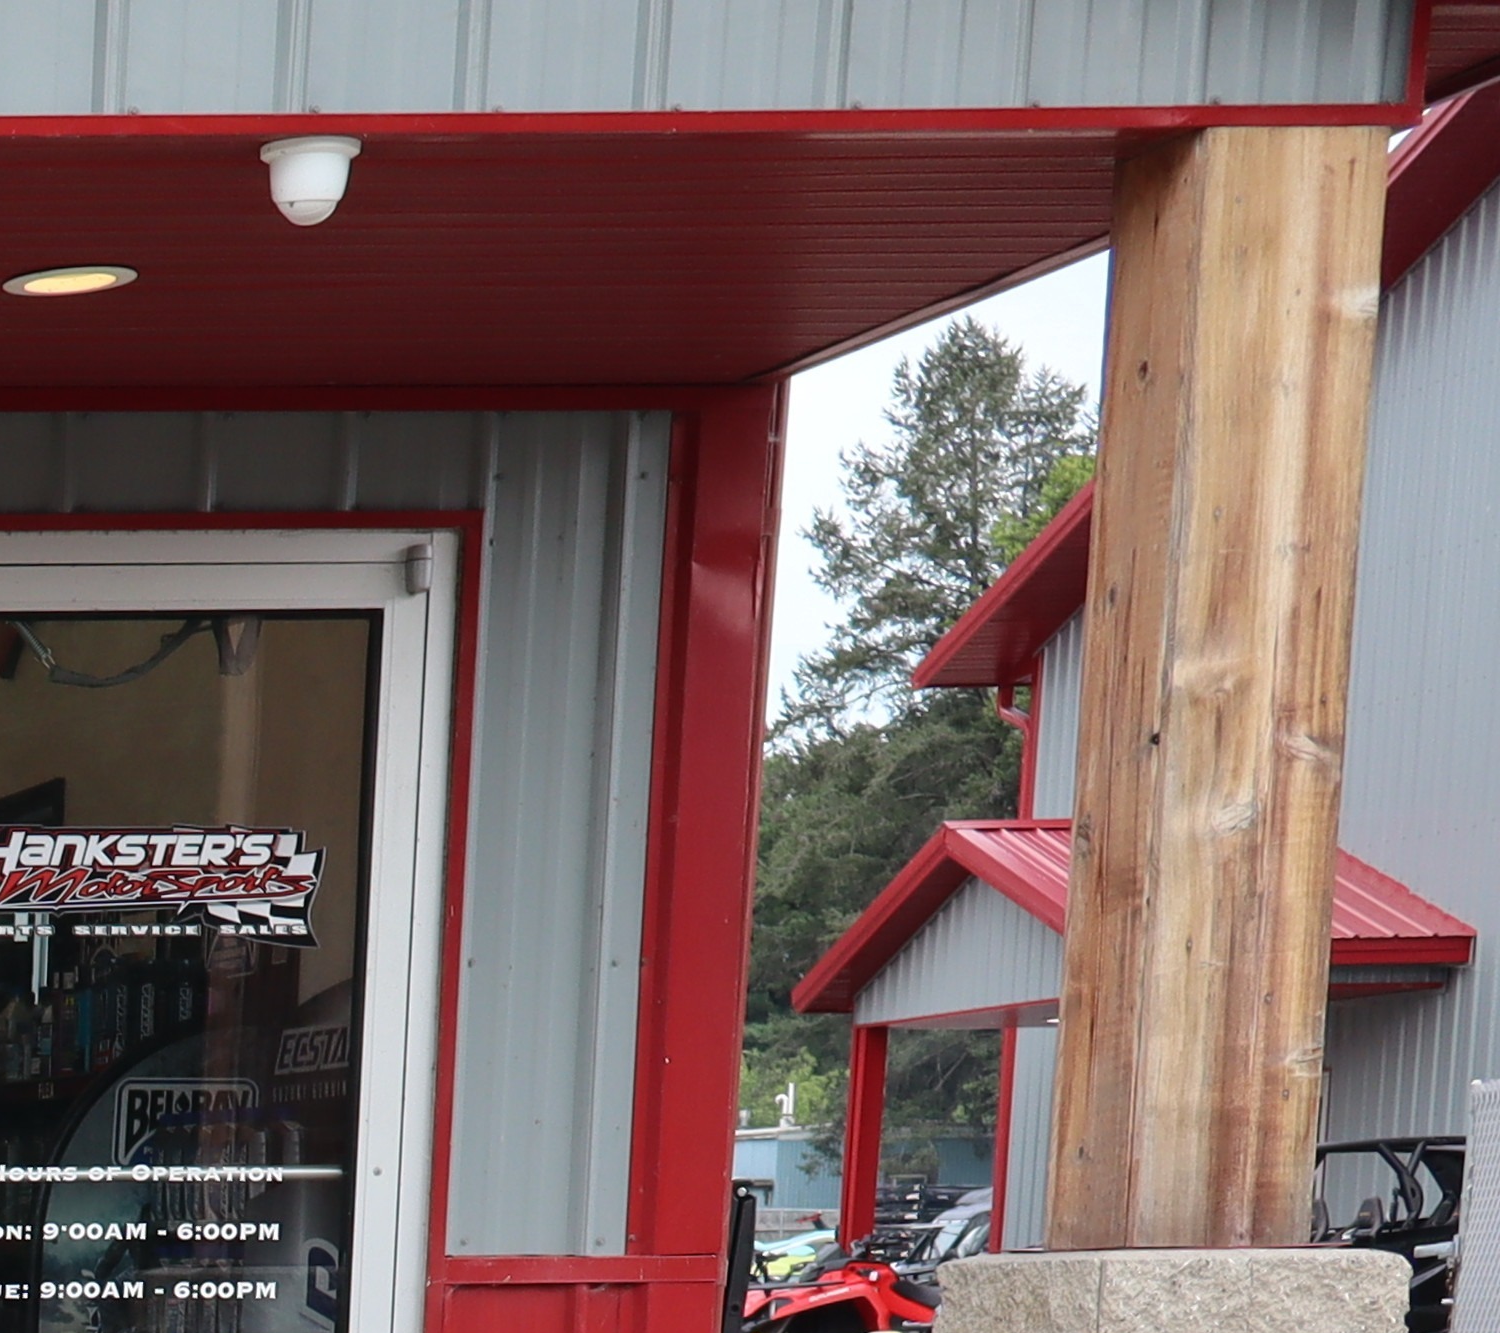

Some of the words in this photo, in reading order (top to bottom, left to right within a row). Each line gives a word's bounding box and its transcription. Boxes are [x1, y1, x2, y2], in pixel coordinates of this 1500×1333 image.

[73, 924, 201, 936] SERVICE
[220, 924, 309, 936] SALES
[178, 1223, 280, 1240] 6:00PM
[40, 1282, 144, 1299] 9:00AM
[175, 1282, 277, 1299] 6:00PM
